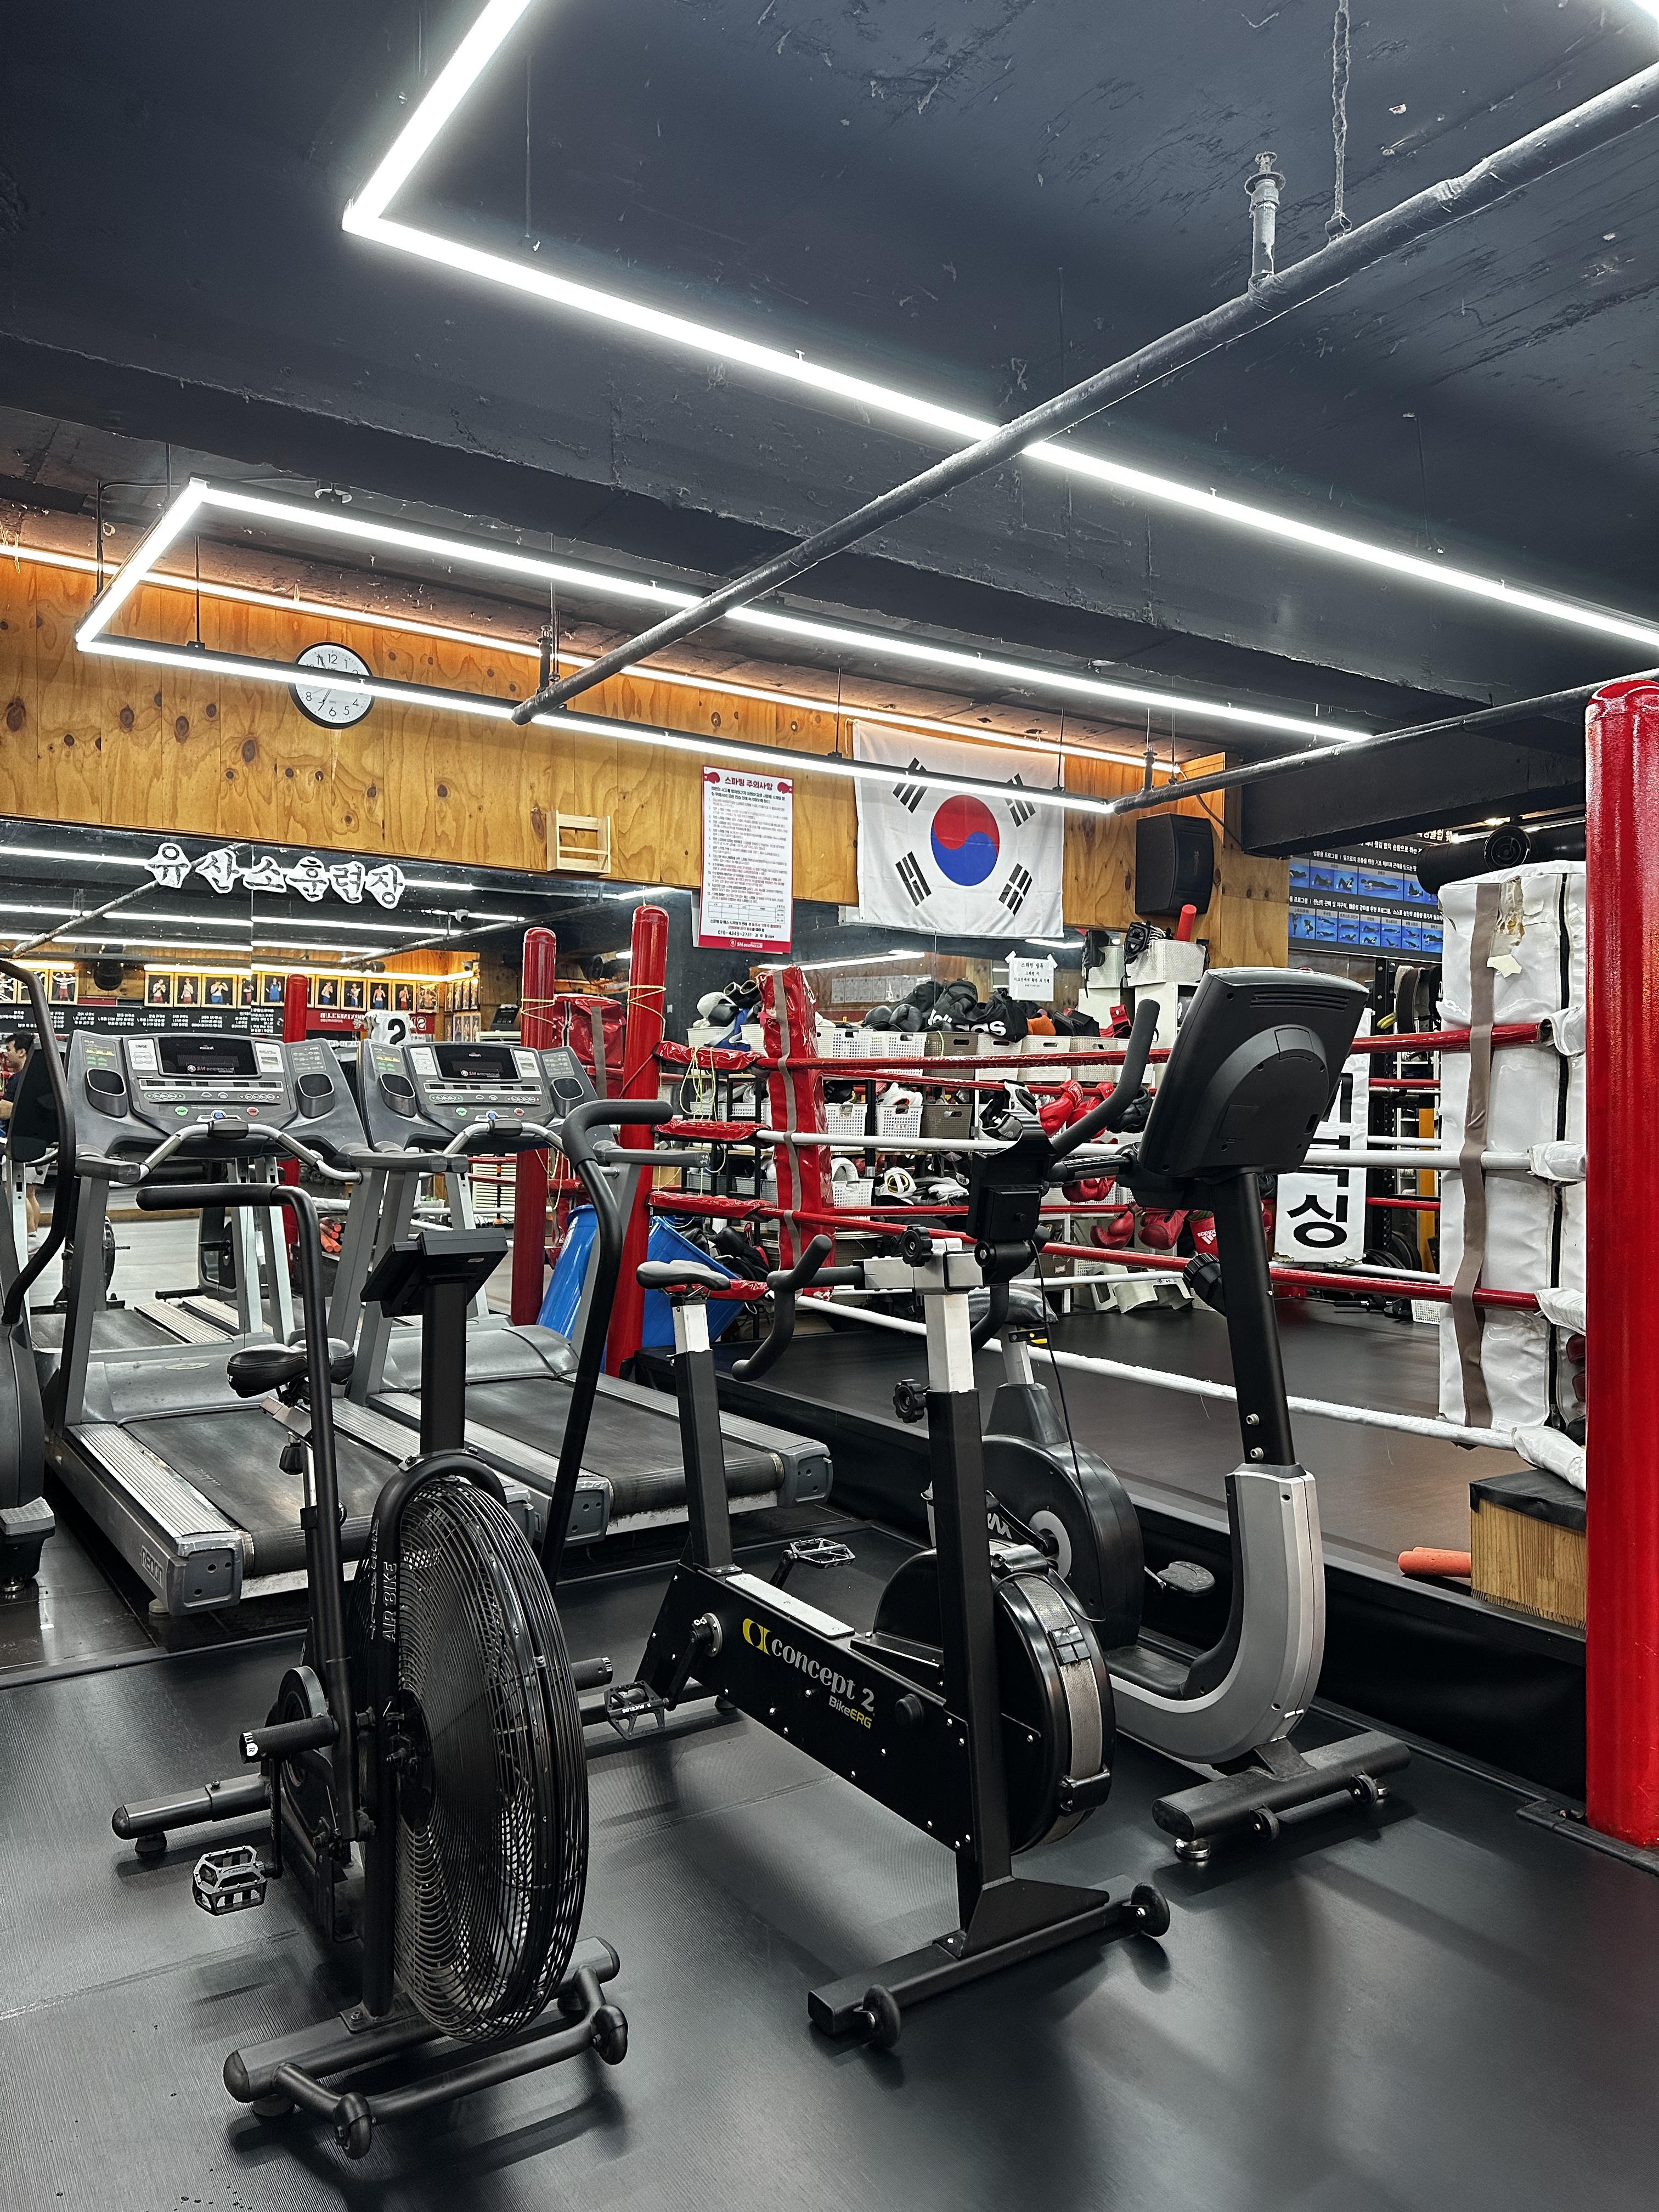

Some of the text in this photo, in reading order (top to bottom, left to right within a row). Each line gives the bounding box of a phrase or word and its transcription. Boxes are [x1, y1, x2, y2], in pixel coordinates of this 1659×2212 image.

[328, 653, 337, 665] 12
[344, 659, 348, 669] 1
[306, 691, 312, 702] 8
[318, 701, 325, 712] 7
[352, 698, 359, 707] 4
[329, 707, 336, 717] 6
[343, 706, 349, 715] 5
[724, 776, 773, 791] 스파링 주의사항
[146, 844, 404, 907] 유산소훈련장
[382, 1561, 397, 1643] AIR BIKE
[771, 1638, 875, 1713] concept 2
[828, 1695, 873, 1729] BikeERG
